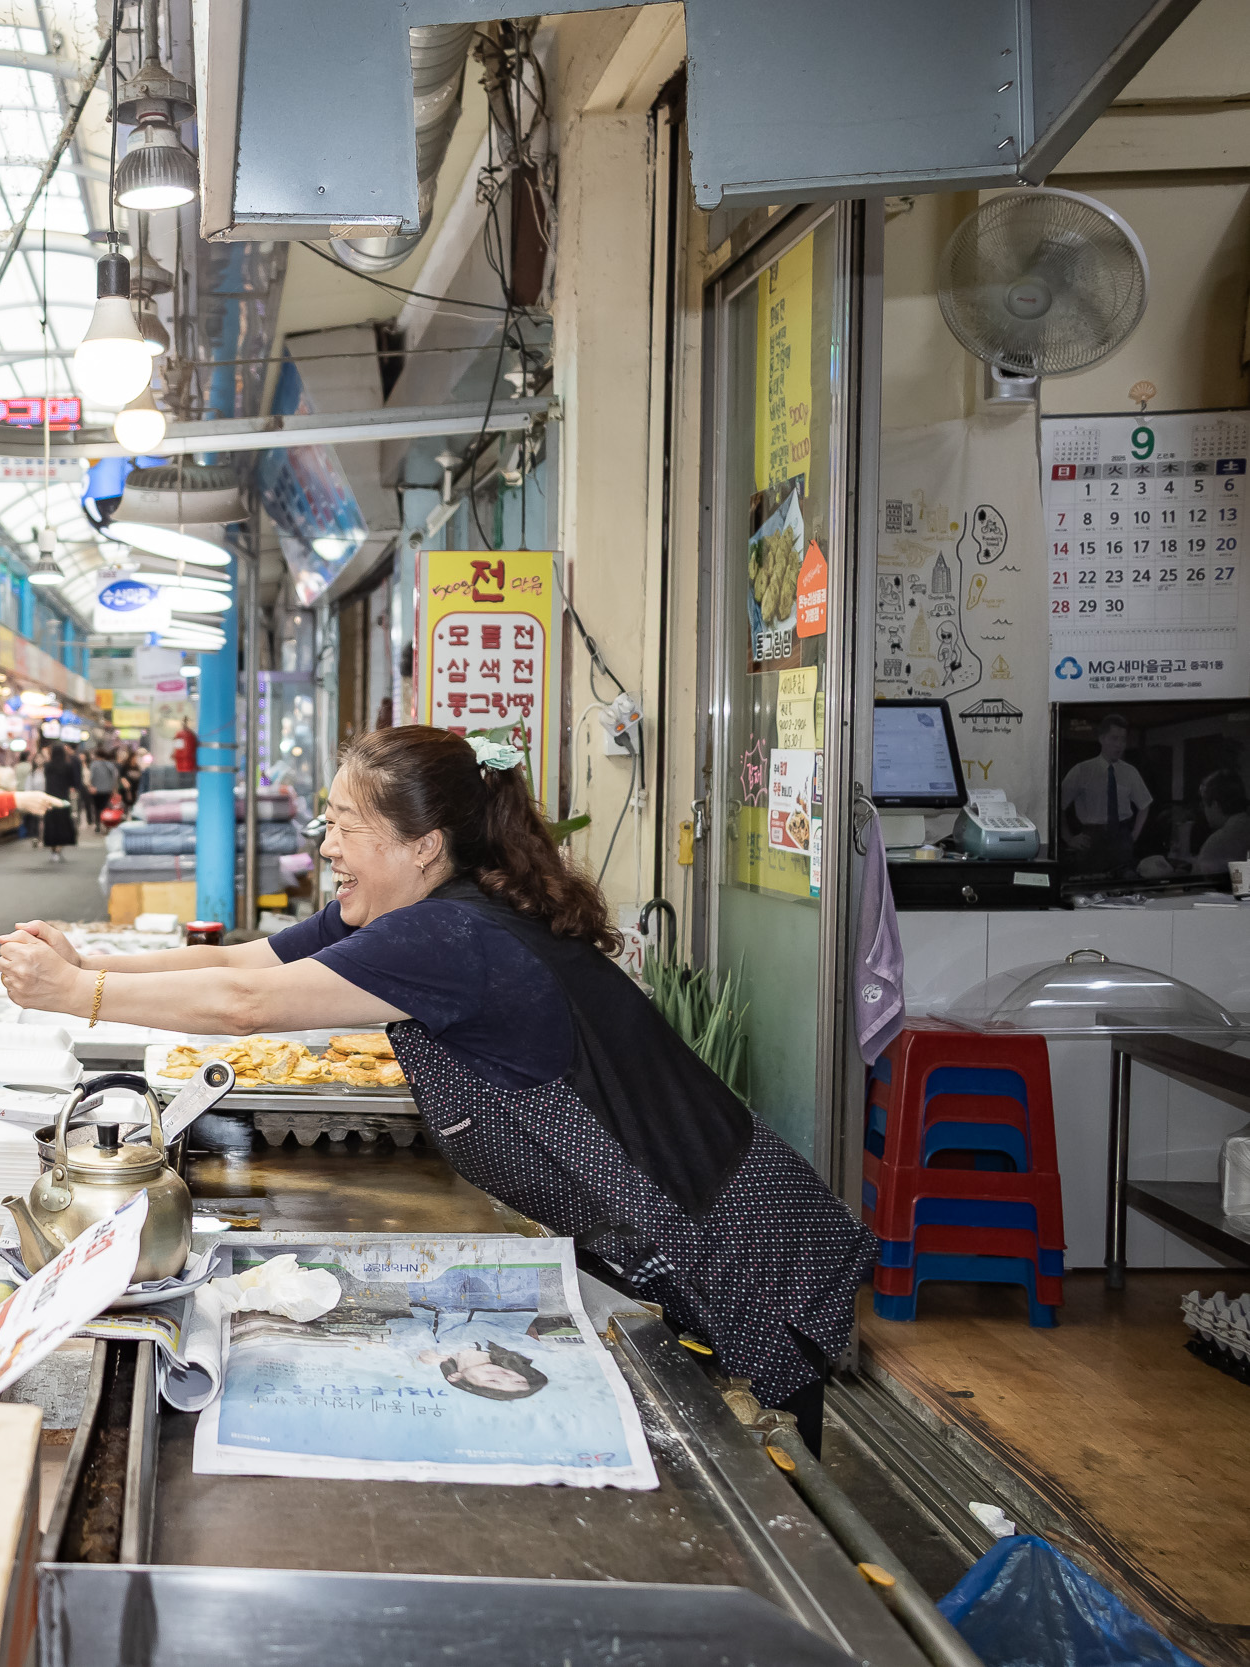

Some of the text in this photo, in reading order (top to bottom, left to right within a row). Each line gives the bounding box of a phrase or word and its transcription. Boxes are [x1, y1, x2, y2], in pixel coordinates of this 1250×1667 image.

[1131, 426, 1155, 460] 9
[1058, 460, 1239, 477] 日 月 火 水 木 金 土
[1085, 478, 1235, 496] 1 2 3 4 5 6
[1057, 508, 1237, 526] 7 8 9 10 11 12 13
[1053, 537, 1237, 555] 14 15 16 17 18 19 20
[470, 559, 505, 603] 전
[1053, 566, 1235, 584] 21 22 23 24 25 26 27
[1051, 599, 1124, 613] 28 29 30
[1190, 661, 1224, 671] 중곡1동
[295, 1395, 365, 1412] 사장님을
[371, 1398, 406, 1415] 동네
[411, 1402, 447, 1419] 우리
